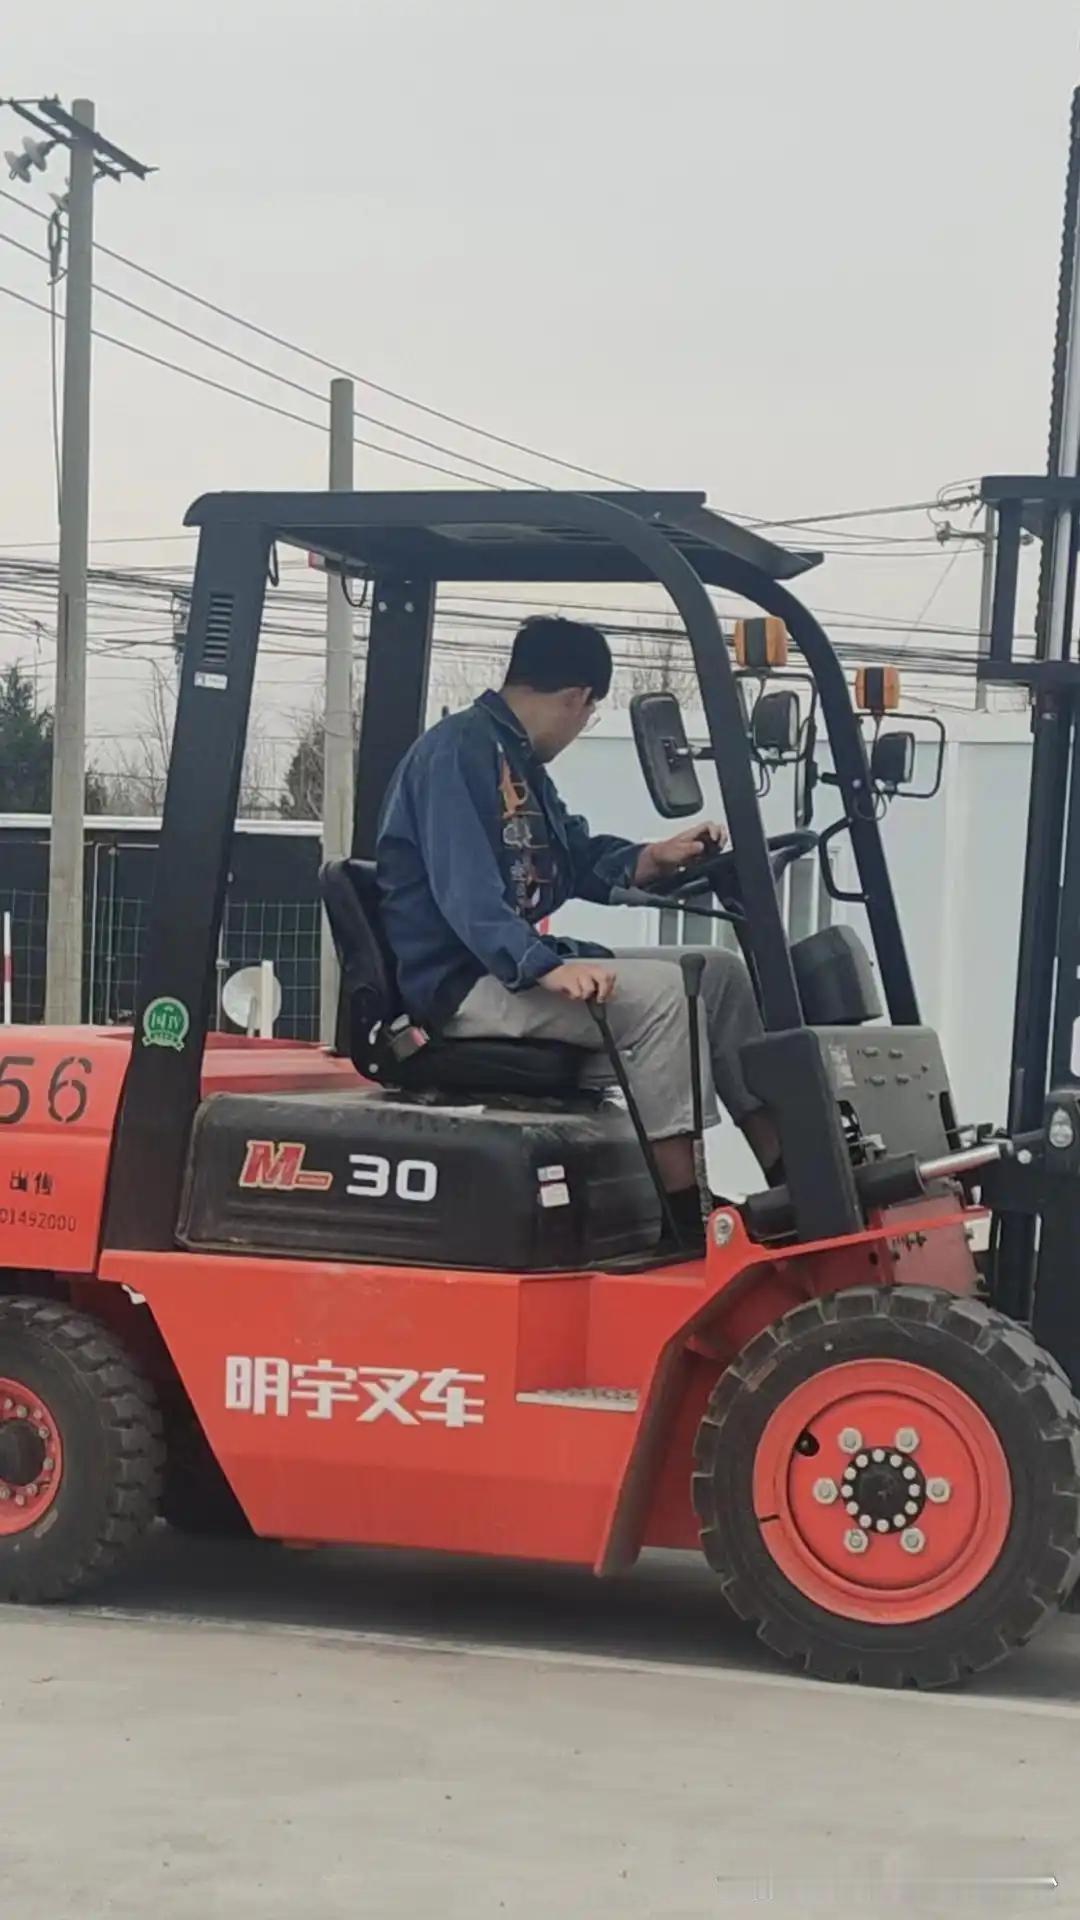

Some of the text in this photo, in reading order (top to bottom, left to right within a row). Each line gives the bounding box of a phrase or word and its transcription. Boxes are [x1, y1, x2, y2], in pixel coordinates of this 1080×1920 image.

[0, 1056, 92, 1124] 56
[346, 1154, 438, 1201] 30
[225, 1355, 485, 1427] 明宇叉车
